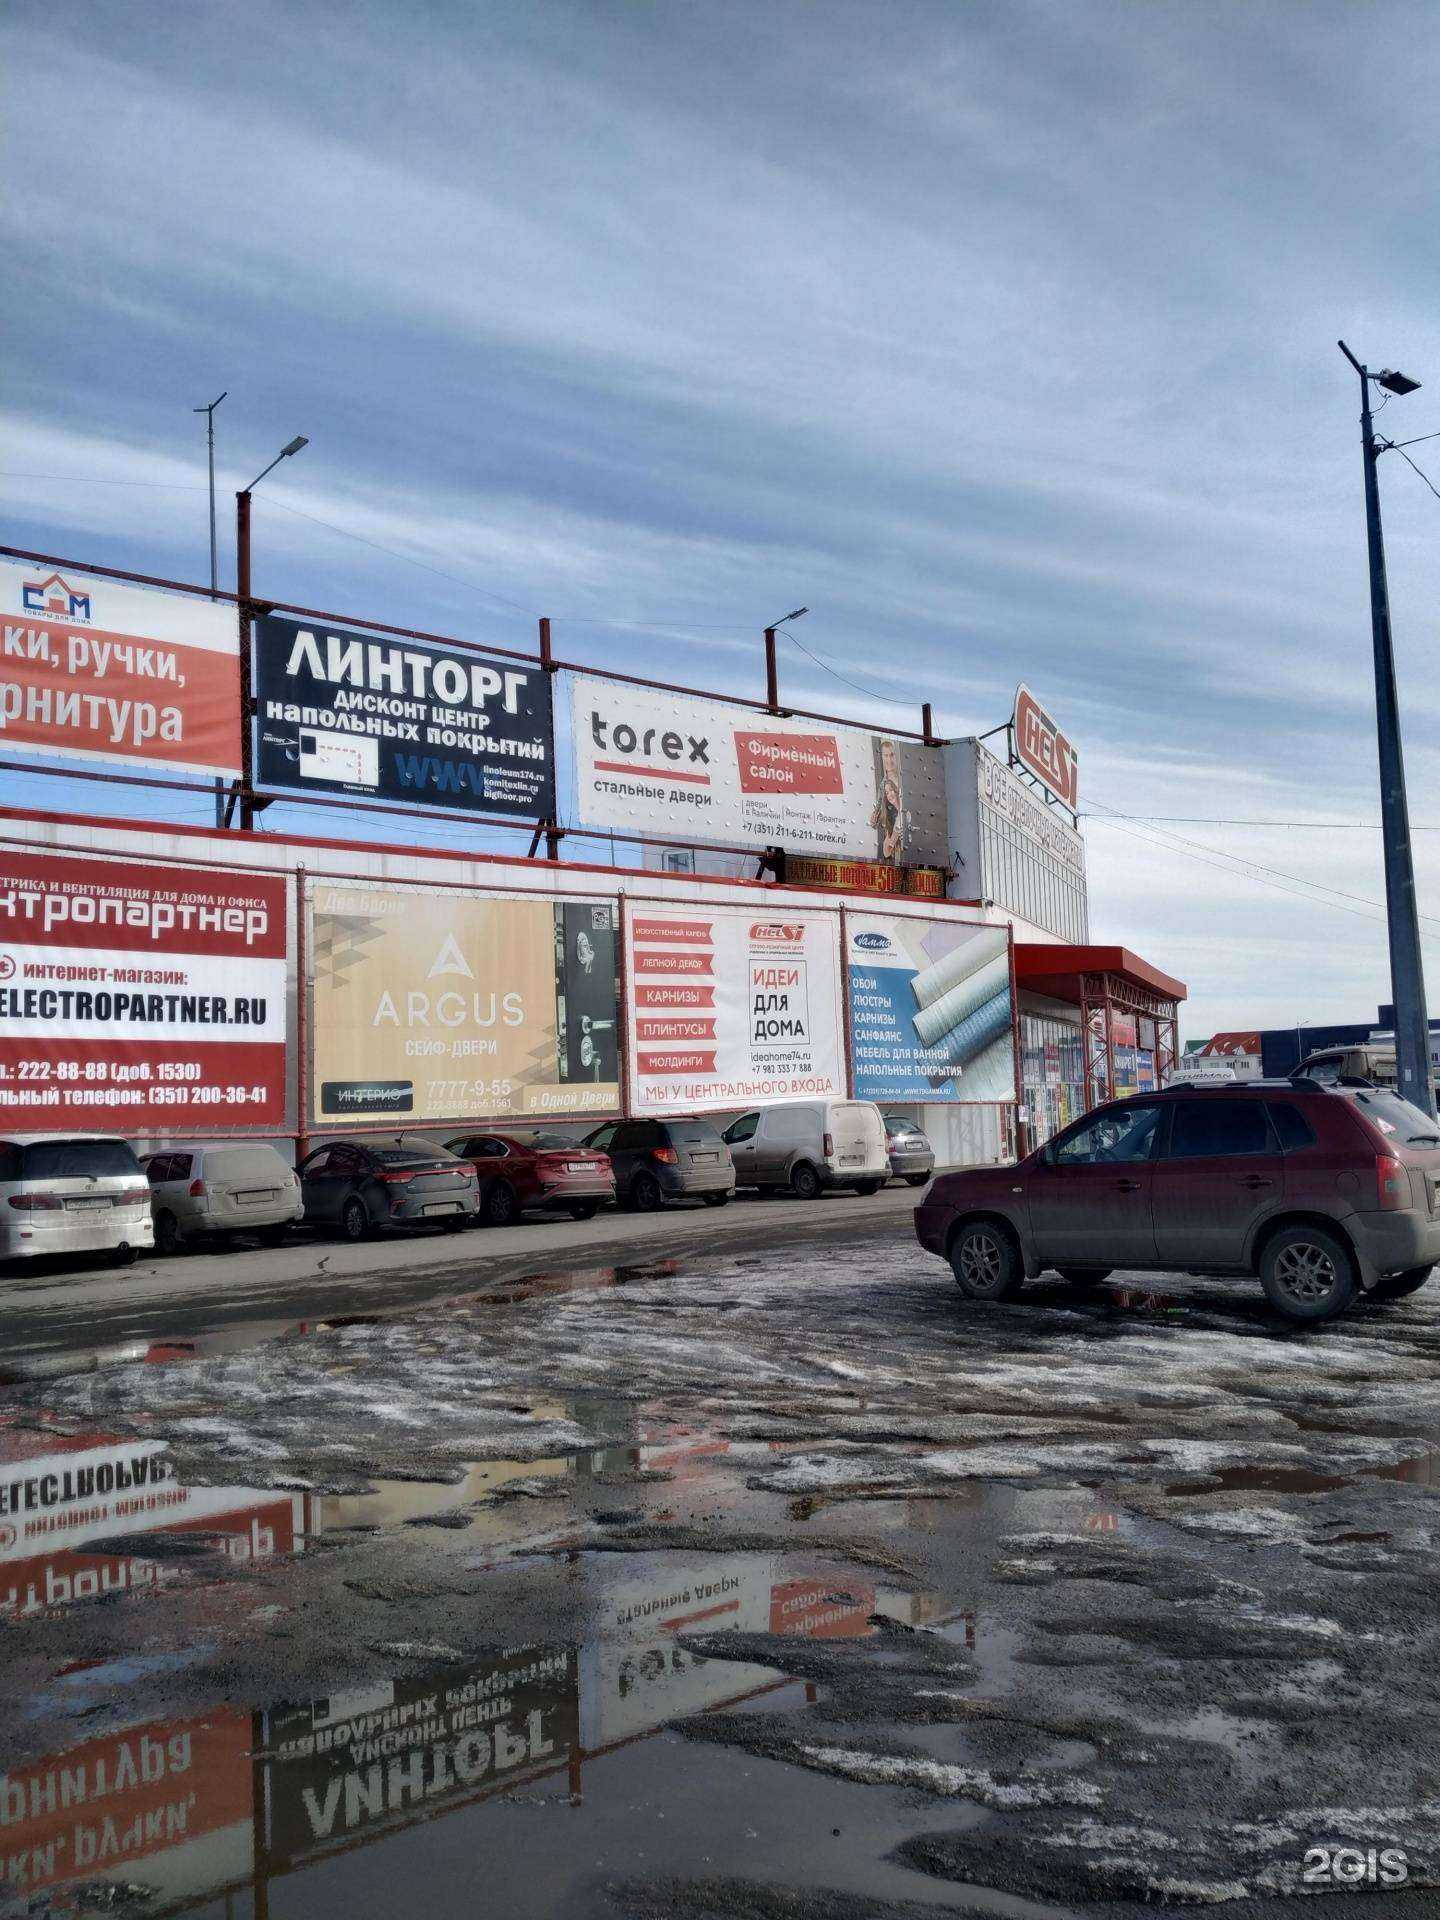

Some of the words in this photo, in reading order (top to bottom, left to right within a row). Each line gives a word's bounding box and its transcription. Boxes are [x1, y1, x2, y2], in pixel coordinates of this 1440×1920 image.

[4, 626, 60, 668] ки,
[68, 636, 186, 688] ручки,
[286, 630, 529, 716] ЛИНТОРГ
[0, 683, 183, 746] рнитура
[334, 690, 427, 721] ДИСКОНТ
[432, 706, 490, 731] ЦЕНТР
[266, 701, 419, 741] напольных
[427, 726, 545, 761] покрытий
[591, 711, 712, 766] torex
[748, 739, 836, 769] Фирменный
[483, 765, 545, 782] linoleum174.ru
[750, 764, 794, 783] салон
[483, 789, 533, 804] bigfloor.pro
[593, 780, 666, 800] стальные
[669, 789, 712, 809] двери
[742, 822, 753, 832] +7
[754, 823, 774, 837] (351)
[776, 826, 813, 840] 211-6-211
[815, 832, 847, 844] torex.ru
[49, 881, 59, 892] И
[62, 882, 150, 900] ВЕНТИЛЯЦИЯ
[152, 890, 178, 903] ДЛЯ
[180, 893, 215, 906] ДОМА
[217, 897, 227, 907] И
[228, 898, 268, 910] ОФИСА
[642, 957, 677, 967] ЛЕПНОЙ
[678, 959, 703, 970] ДЕКОР
[23, 963, 189, 986] интернет-магазин:
[753, 969, 799, 990] ИДЕИ
[852, 977, 877, 990] ОБОИ
[646, 990, 700, 1003] КАРНИЗЫ
[754, 994, 789, 1015] ДЛЯ
[853, 996, 892, 1008] ЛЮСТРЫ
[0, 988, 267, 1026] ELECTROPARTNER.RU
[372, 991, 525, 1027] ARGUS
[854, 1013, 896, 1025] КАРНИЗЫ
[643, 1023, 707, 1036] ПЛИНТУСЫ
[754, 1020, 805, 1041] ДОМА
[855, 1030, 903, 1042] САНФАЯНС
[405, 1039, 498, 1058] СЕЙФ-ДВЕРИ
[750, 1051, 811, 1063] ideahome74.ru
[856, 1047, 891, 1059] МЕБЕЛЬ
[892, 1048, 911, 1060] ДЛЯ
[913, 1047, 950, 1060] ВАННОЙ
[18, 1061, 108, 1081] 222-88-88
[111, 1063, 154, 1081] (доб.
[156, 1062, 201, 1080] 1530)
[649, 1055, 703, 1067] МОЛДИНГИ
[752, 1064, 760, 1074] +7
[762, 1063, 775, 1074] 982
[777, 1063, 790, 1073] 333
[799, 1063, 812, 1073] 888
[857, 1065, 912, 1076] НАПОЛЬНЫЕ
[914, 1065, 963, 1077] ПОКРЫТИЯ
[63, 1089, 146, 1107] телефон:
[149, 1087, 188, 1105] (351)
[192, 1086, 267, 1105] 200-36-41
[426, 1079, 512, 1098] 7777-9-55
[646, 1086, 669, 1100] МЫ
[672, 1085, 681, 1099] У
[685, 1080, 788, 1101] ЦЕНТРАЛЬНОГО
[792, 1078, 833, 1093] ВХОДА
[530, 1096, 537, 1108] в
[541, 1092, 577, 1108] Одной
[579, 1091, 615, 1107] Двери
